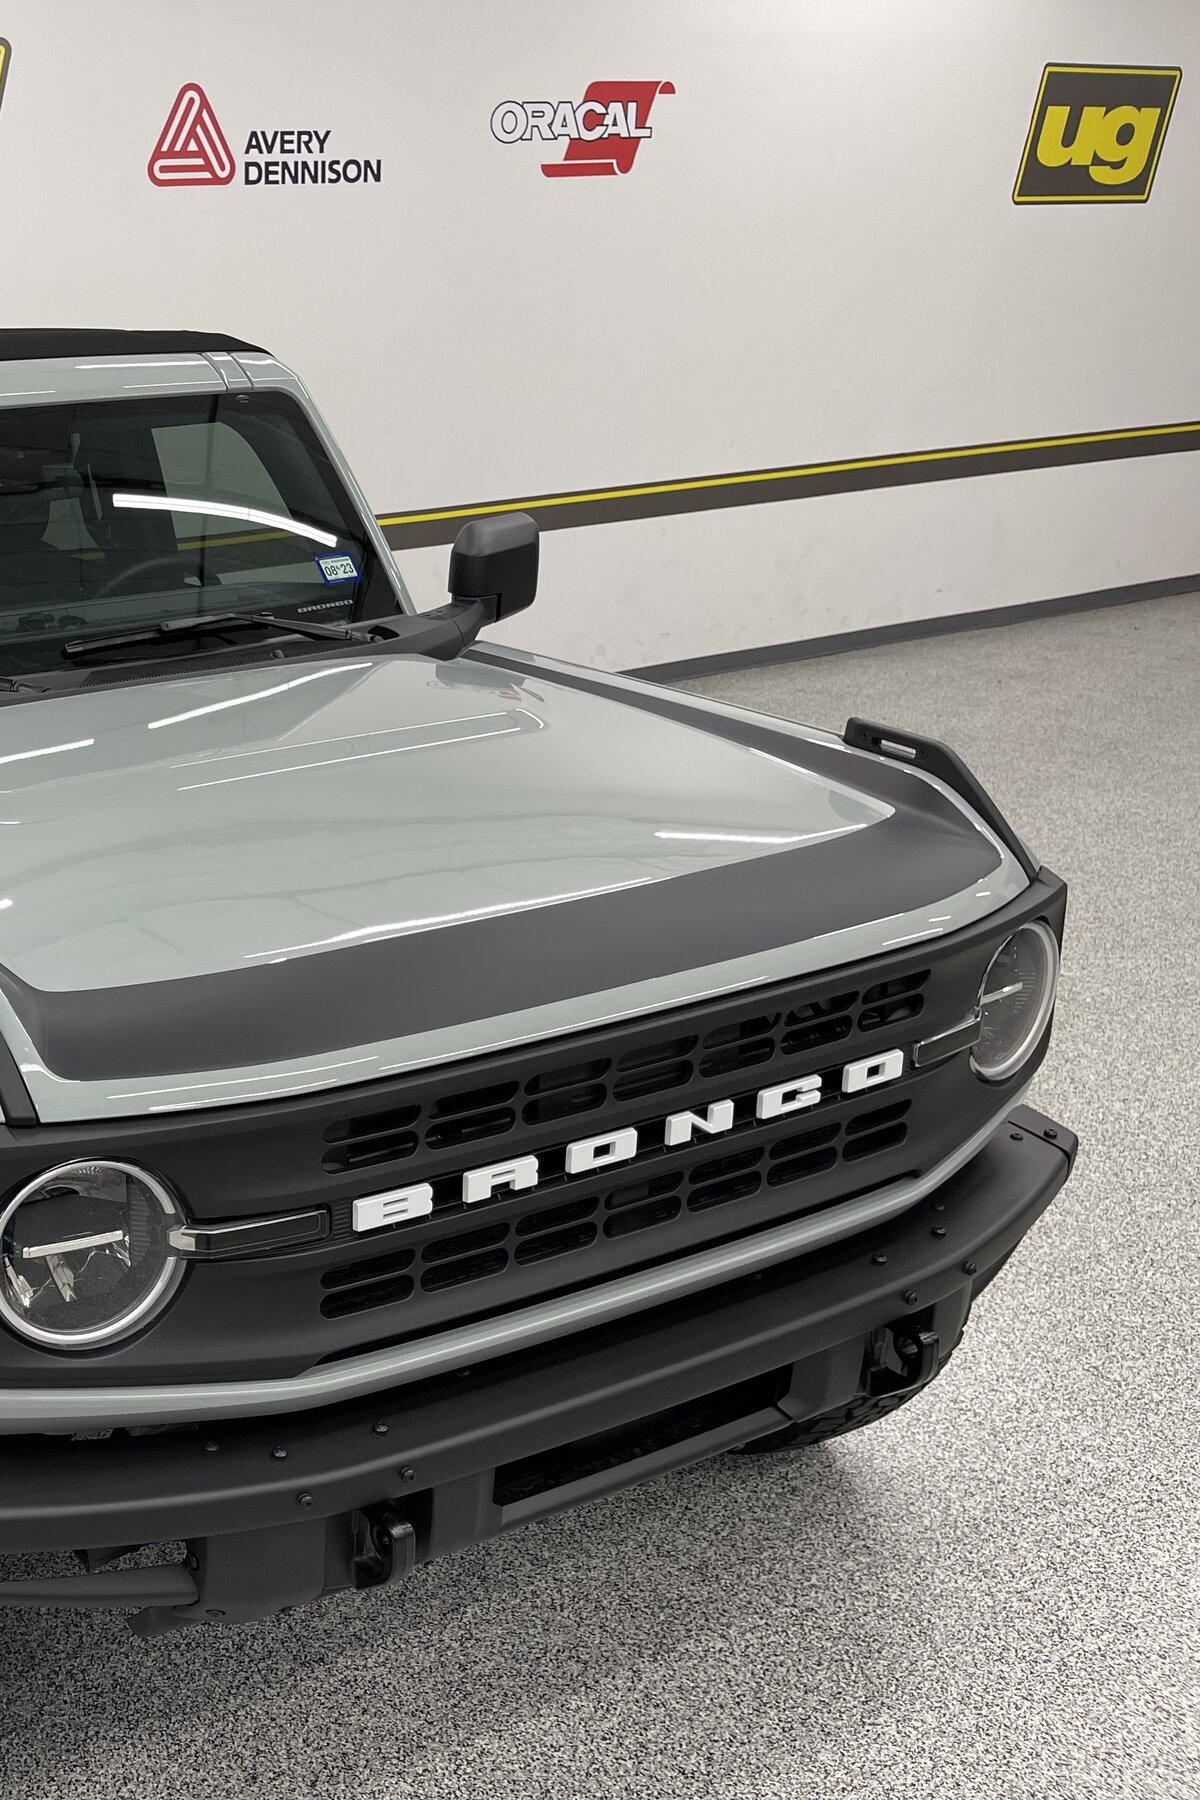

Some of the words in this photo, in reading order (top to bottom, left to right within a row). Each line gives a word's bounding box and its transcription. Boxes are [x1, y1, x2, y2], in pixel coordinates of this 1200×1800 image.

[244, 130, 331, 154] AVERY
[490, 100, 653, 144] ORACAL
[1036, 105, 1161, 185] ug
[244, 159, 382, 185] DENNISON
[353, 1048, 904, 1233] BRONCO
